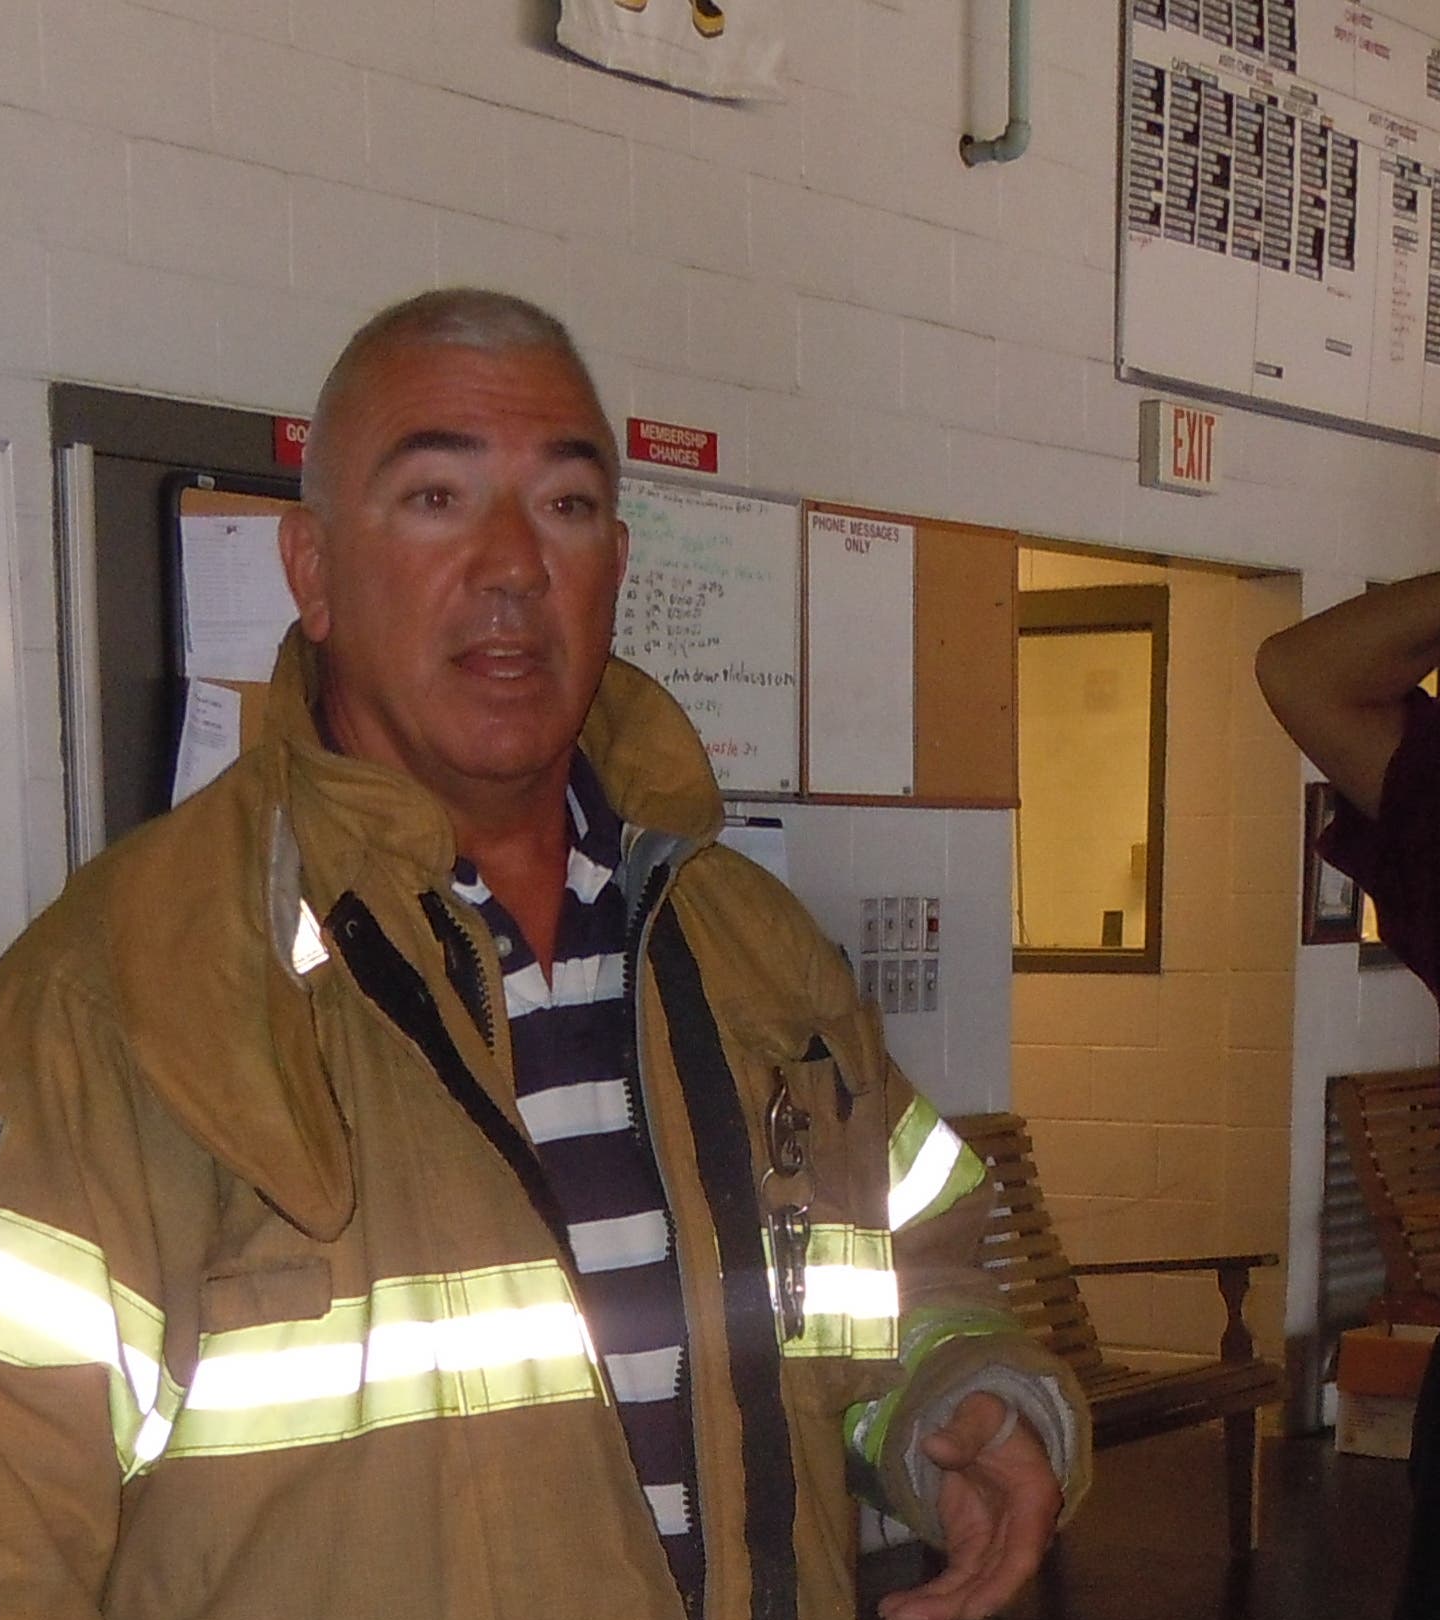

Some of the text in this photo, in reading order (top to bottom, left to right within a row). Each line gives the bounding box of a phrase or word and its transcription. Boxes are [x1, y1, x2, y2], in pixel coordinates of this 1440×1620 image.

[639, 422, 709, 449] MEMBERSHIP
[1173, 408, 1216, 483] EXIT
[649, 443, 700, 467] CHANGES
[812, 515, 900, 543] PHONE MESSAGES
[844, 537, 871, 554] ONLY
